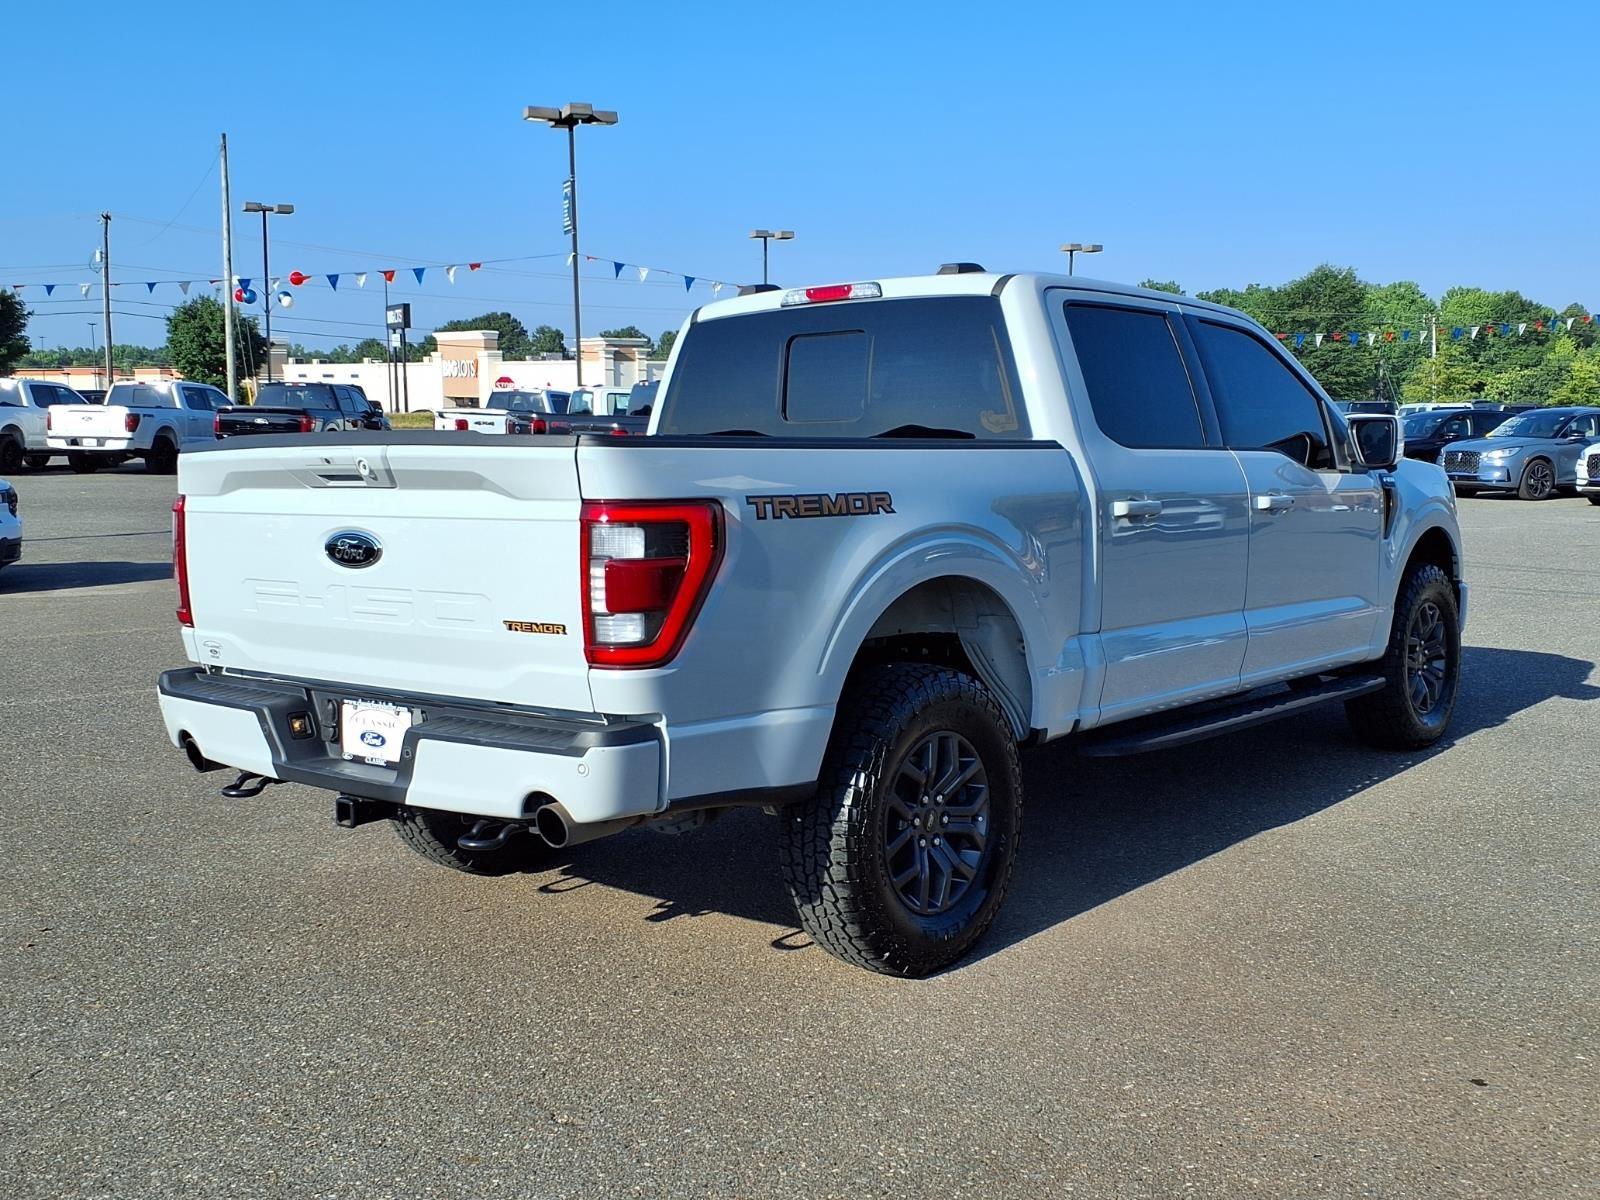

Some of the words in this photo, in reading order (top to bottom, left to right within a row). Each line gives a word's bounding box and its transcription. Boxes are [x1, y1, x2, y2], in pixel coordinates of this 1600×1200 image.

[745, 492, 897, 520] TREMOR
[334, 537, 367, 560] Ford
[503, 620, 567, 635] TREMOR
